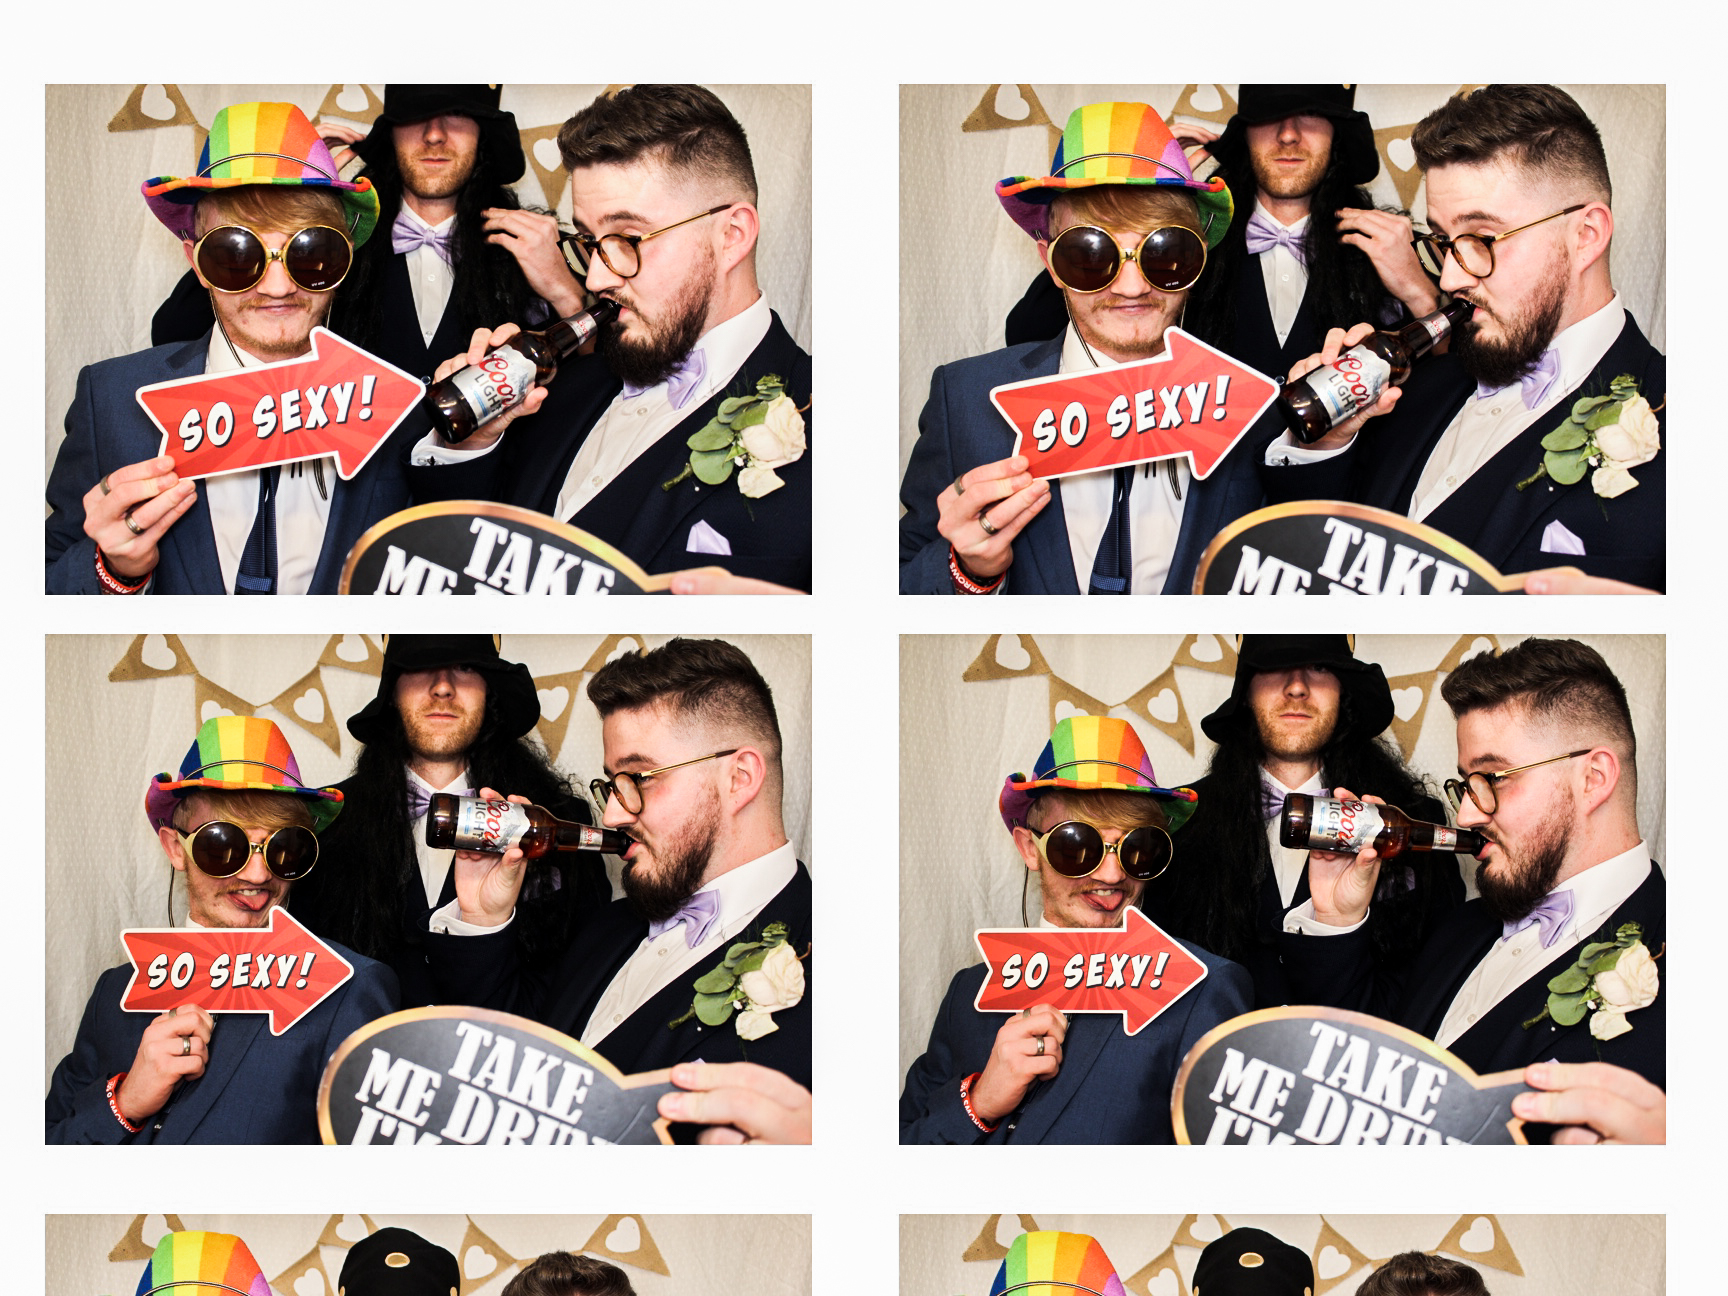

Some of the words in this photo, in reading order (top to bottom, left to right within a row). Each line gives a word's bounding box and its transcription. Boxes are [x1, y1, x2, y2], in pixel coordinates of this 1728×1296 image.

[178, 401, 235, 452] SO
[252, 374, 377, 439] SEXY!
[478, 353, 517, 407] Coor
[1032, 401, 1089, 452] SO
[1106, 374, 1231, 439] SEXY!
[1332, 353, 1371, 407] Coor
[373, 544, 458, 595] ME
[463, 516, 615, 595] TAKE
[1227, 544, 1312, 595] ME
[1317, 516, 1469, 595] TAKE
[147, 951, 196, 990] SO
[209, 951, 317, 990] SEXY!
[1001, 951, 1050, 990] SO
[1063, 951, 1171, 990] SEXY!
[354, 1047, 442, 1127] ME
[448, 1020, 595, 1125] TAKE
[1208, 1047, 1296, 1127] ME
[1302, 1020, 1449, 1125] TAKE
